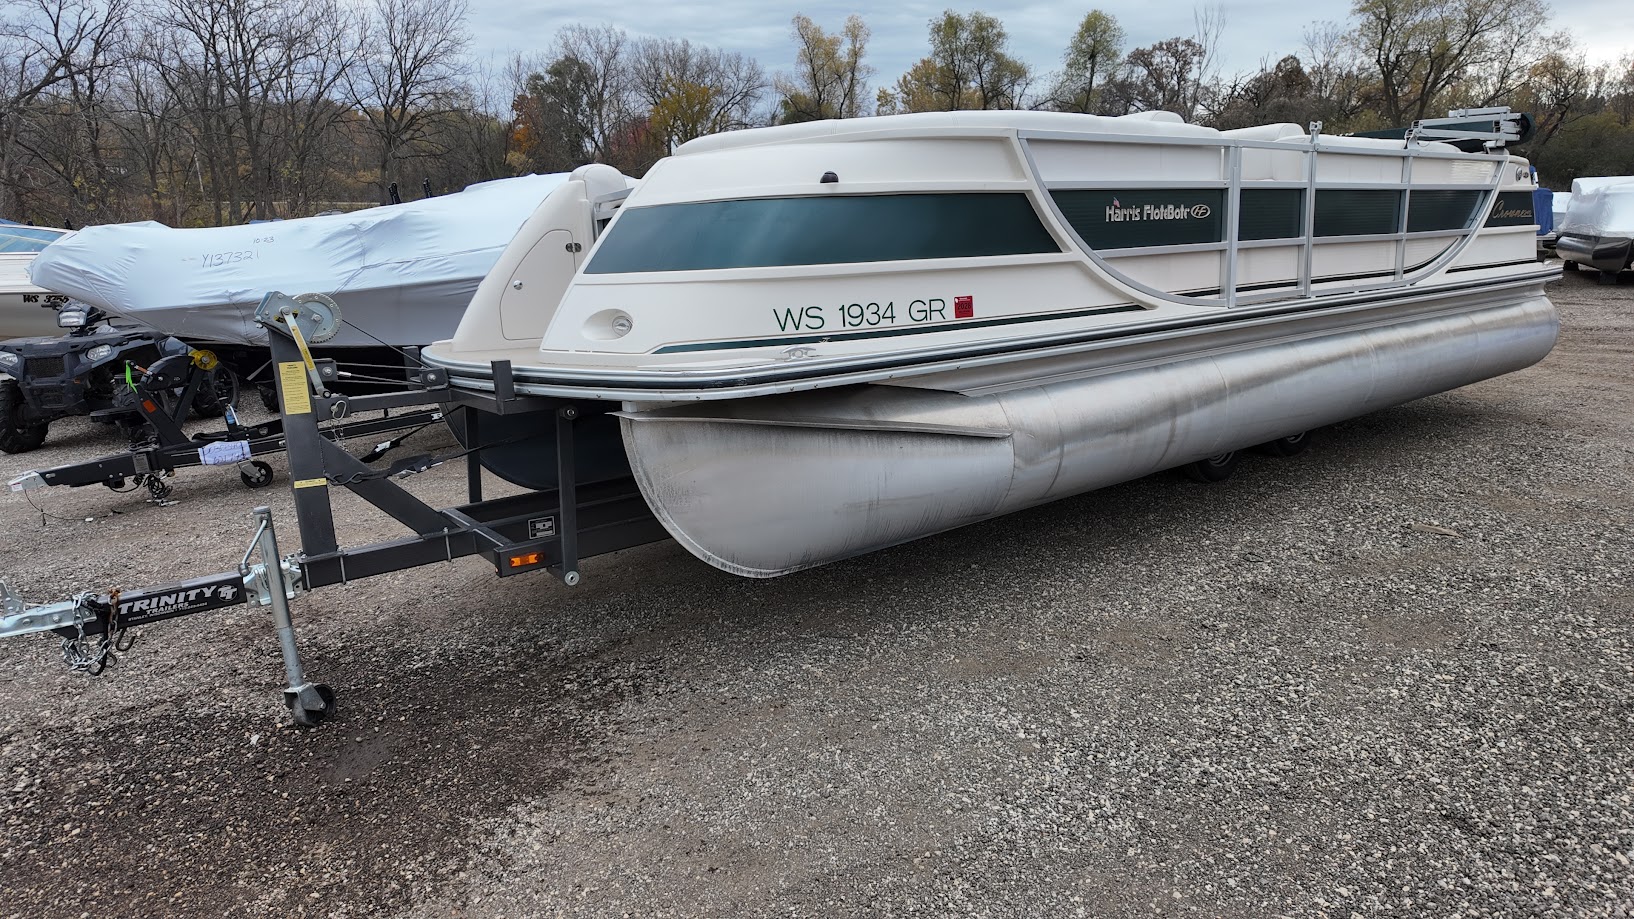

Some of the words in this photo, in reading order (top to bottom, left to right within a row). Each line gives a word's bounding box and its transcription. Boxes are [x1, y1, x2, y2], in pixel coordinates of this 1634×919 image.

[1105, 205, 1140, 222] Harris
[202, 248, 259, 268] Y137321
[23, 295, 39, 303] WS
[773, 306, 825, 332] WS
[838, 301, 896, 328] 1934
[908, 298, 946, 322] GR
[118, 585, 217, 615] TRINITY
[146, 602, 189, 615] TRAILERS
